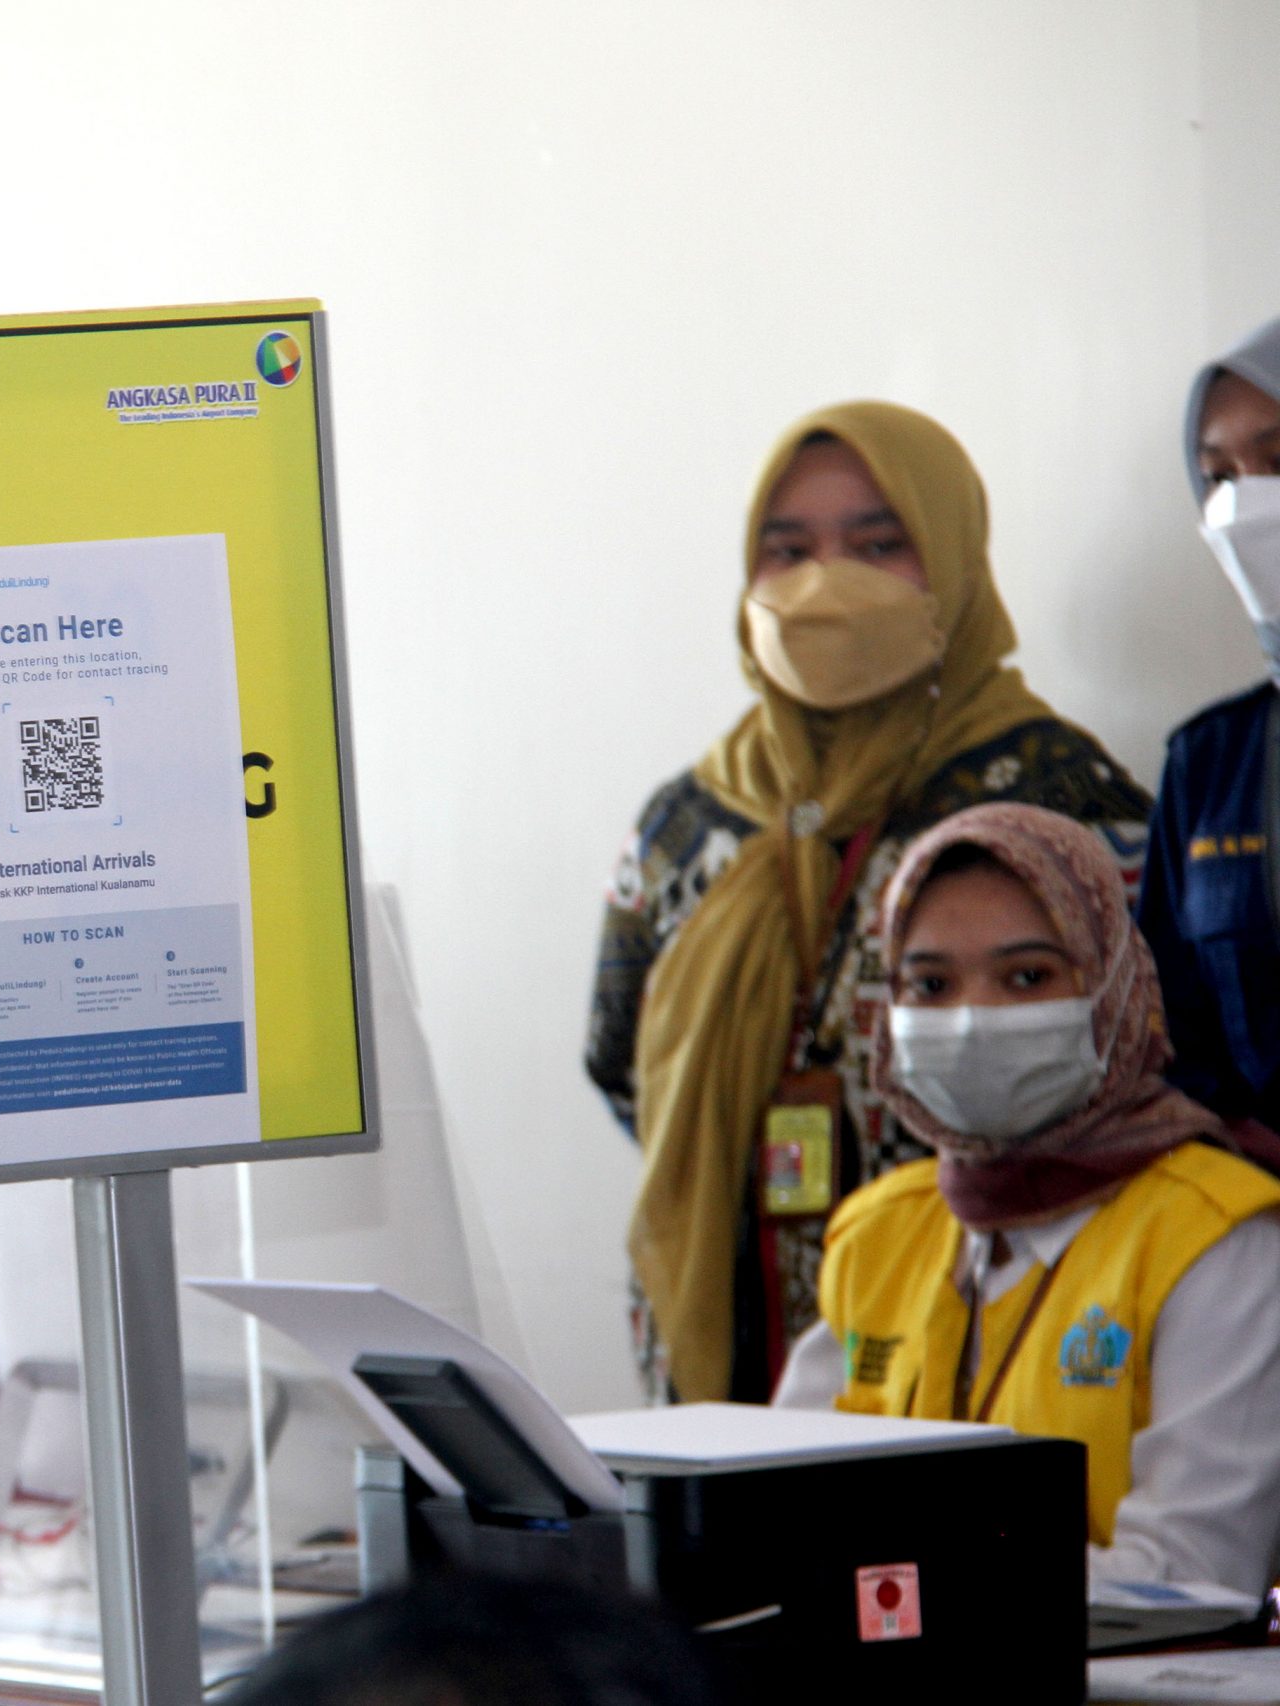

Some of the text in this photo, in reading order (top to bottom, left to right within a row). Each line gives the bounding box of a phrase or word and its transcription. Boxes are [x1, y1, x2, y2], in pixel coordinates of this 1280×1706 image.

[107, 387, 190, 408] ANGKASA
[195, 383, 241, 403] PURA
[58, 615, 123, 640] Here
[11, 655, 58, 669] entering
[63, 652, 85, 664] this
[90, 650, 142, 662] location,
[2, 672, 18, 684] QR
[23, 670, 52, 682] Code
[57, 668, 73, 680] for
[78, 666, 122, 679] contact
[127, 664, 168, 677] tracing
[92, 851, 156, 871] Arrivals
[14, 886, 34, 897] KKP
[37, 881, 98, 895] International
[101, 879, 155, 891] Kualanamu
[23, 926, 124, 944] HOW TO SCAN
[76, 972, 139, 984] Create Account
[167, 965, 227, 977] Start Scanning
